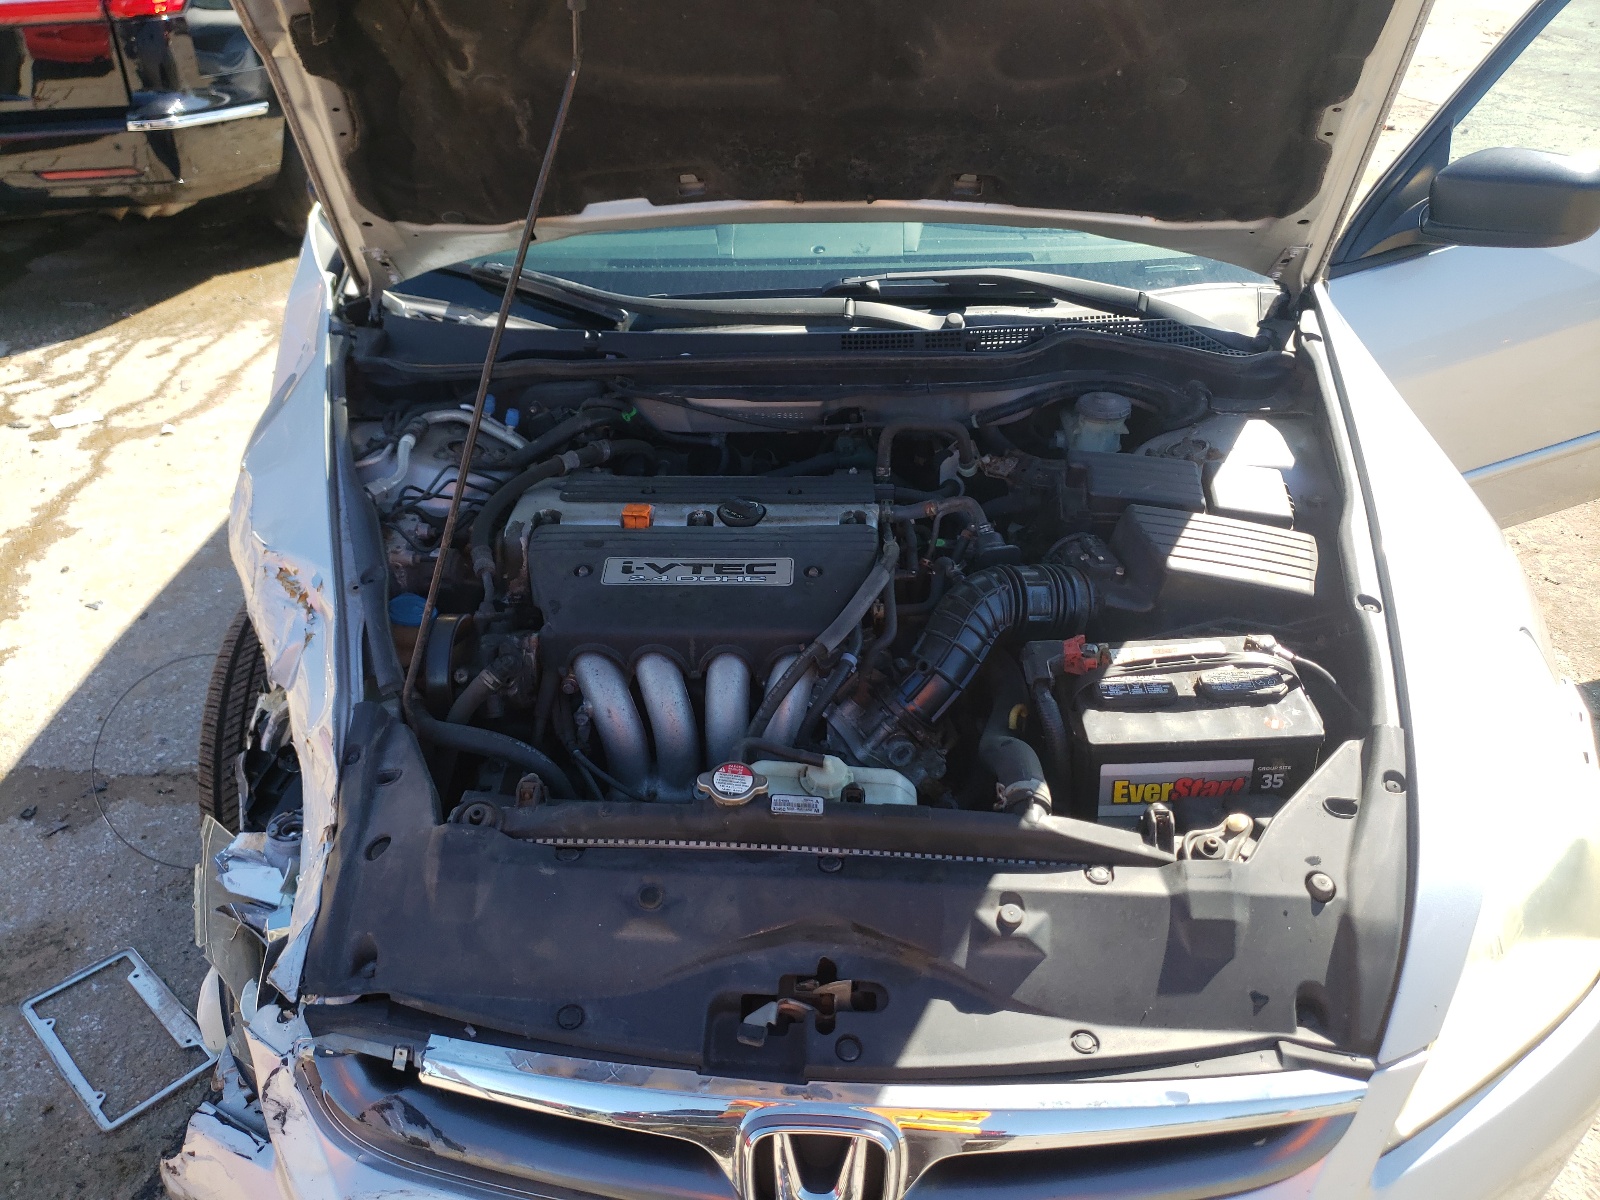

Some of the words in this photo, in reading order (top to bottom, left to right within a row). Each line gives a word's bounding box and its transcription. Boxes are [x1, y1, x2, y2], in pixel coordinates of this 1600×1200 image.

[621, 561, 776, 575] i-VTEC
[1260, 773, 1285, 789] 35
[1113, 777, 1246, 804] EverStart
